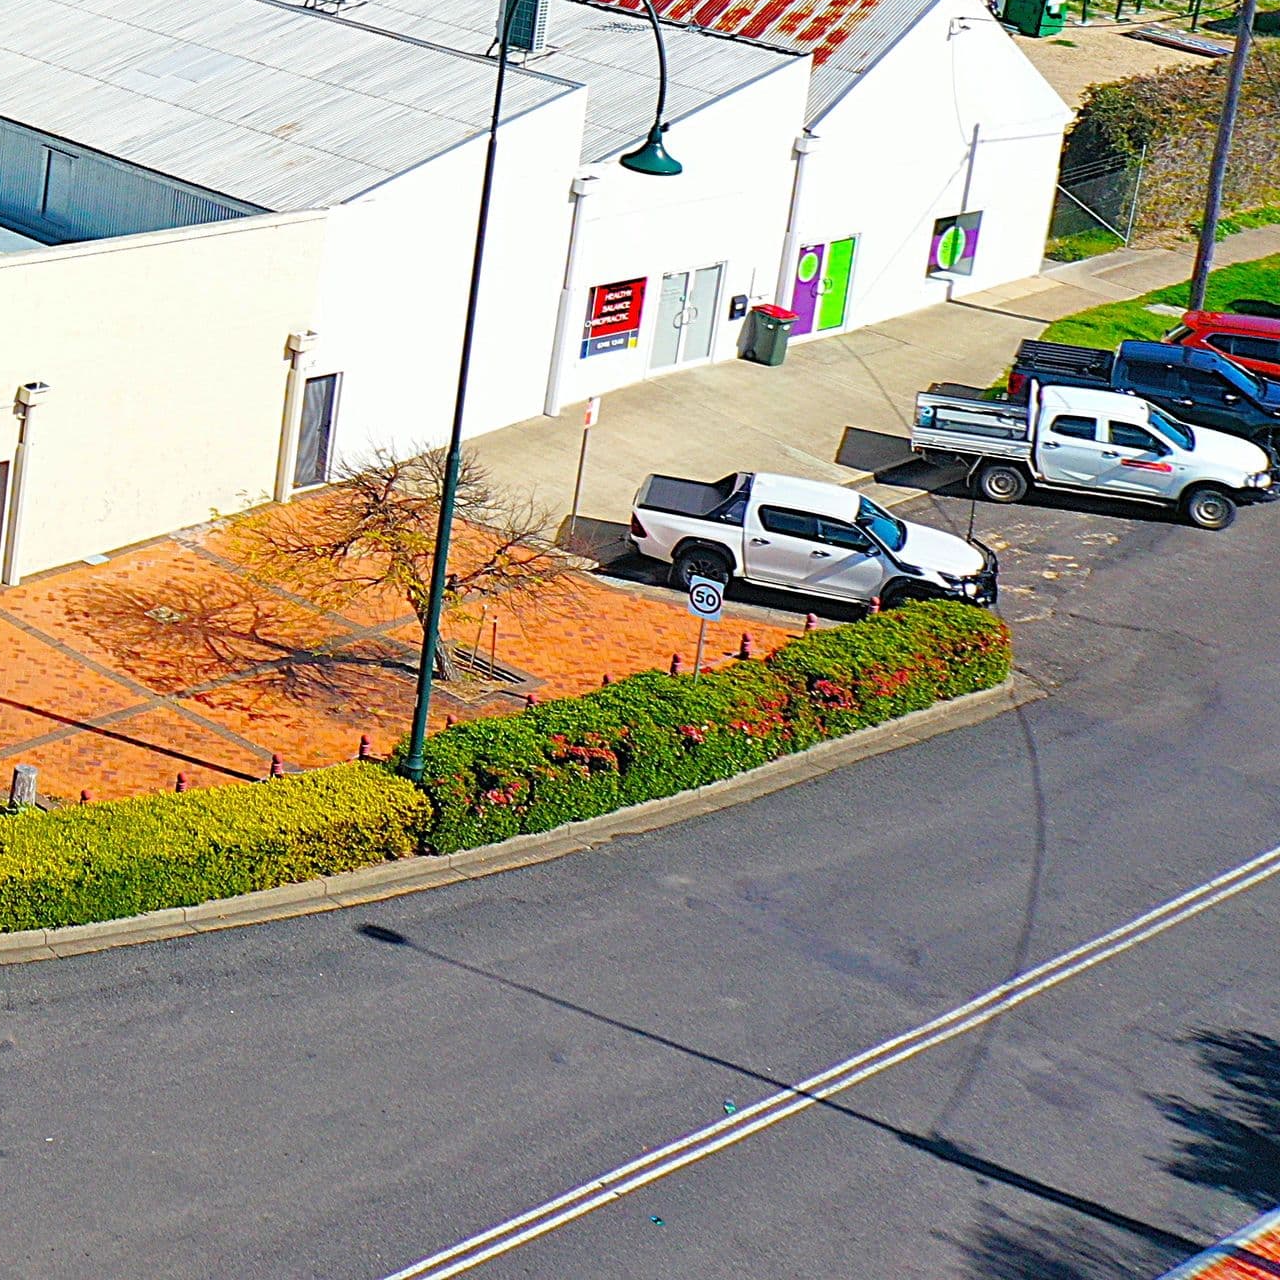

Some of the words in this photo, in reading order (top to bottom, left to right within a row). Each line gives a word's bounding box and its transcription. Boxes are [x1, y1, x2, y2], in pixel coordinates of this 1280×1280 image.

[604, 289, 633, 301] HEALTHY
[602, 301, 632, 313] BALANCE
[584, 312, 630, 328] CHIROPRACTIC
[695, 590, 716, 607] 50
